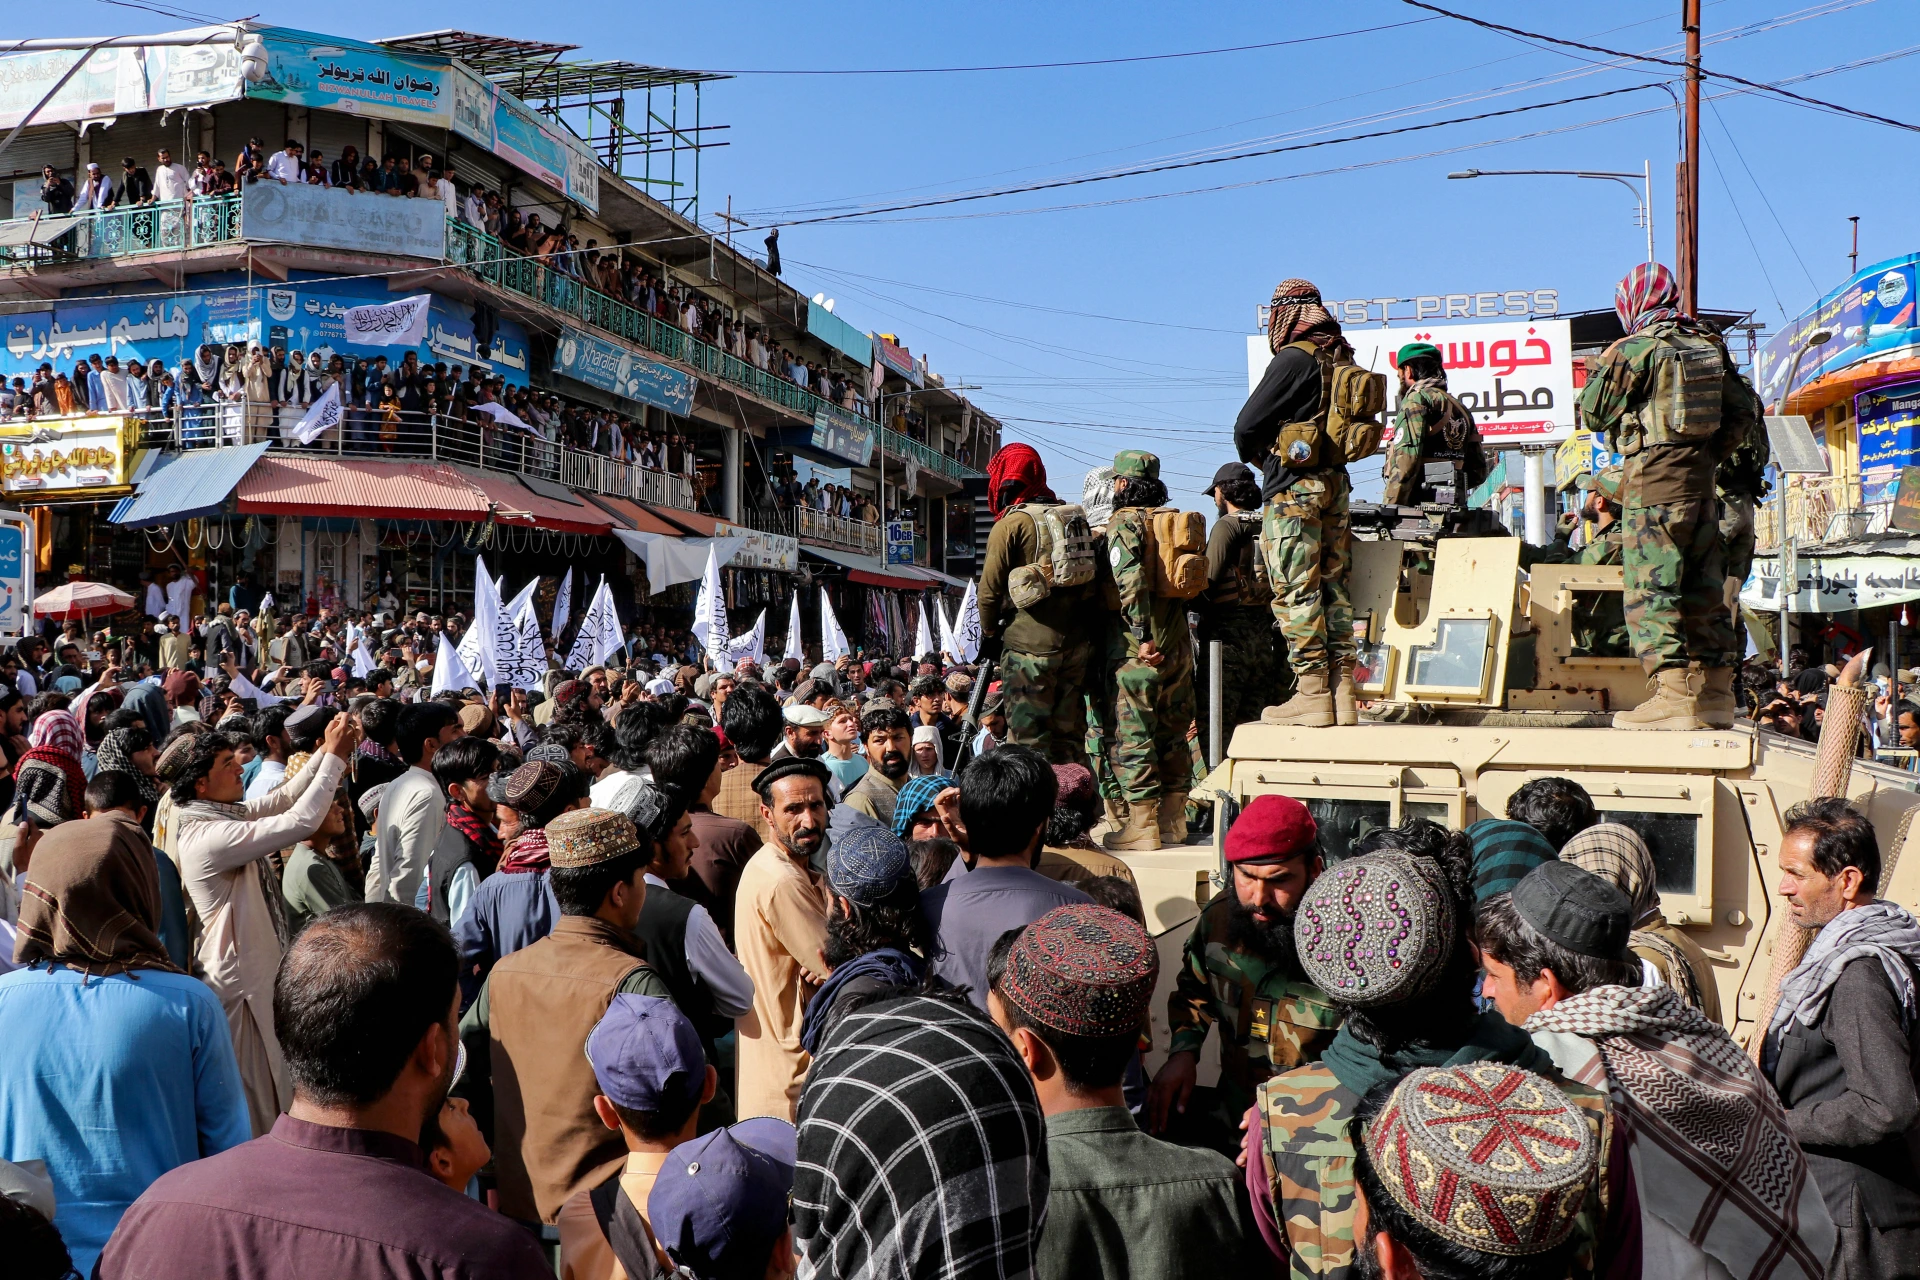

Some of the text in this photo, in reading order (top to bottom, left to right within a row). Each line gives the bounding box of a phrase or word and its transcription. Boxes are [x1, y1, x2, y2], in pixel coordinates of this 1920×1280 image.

[367, 68, 390, 86] الله
[393, 74, 440, 96] رضوان
[318, 82, 437, 109] RIZWANULLAH TRAVELS
[358, 229, 404, 247] Printing
[407, 235, 440, 248] Press
[1415, 288, 1559, 321] PRESS
[6, 301, 189, 360] هاشم سپورټ
[1388, 326, 1552, 377] خوست
[1519, 423, 1541, 431] خوست
[1861, 416, 1891, 436] شرکت
